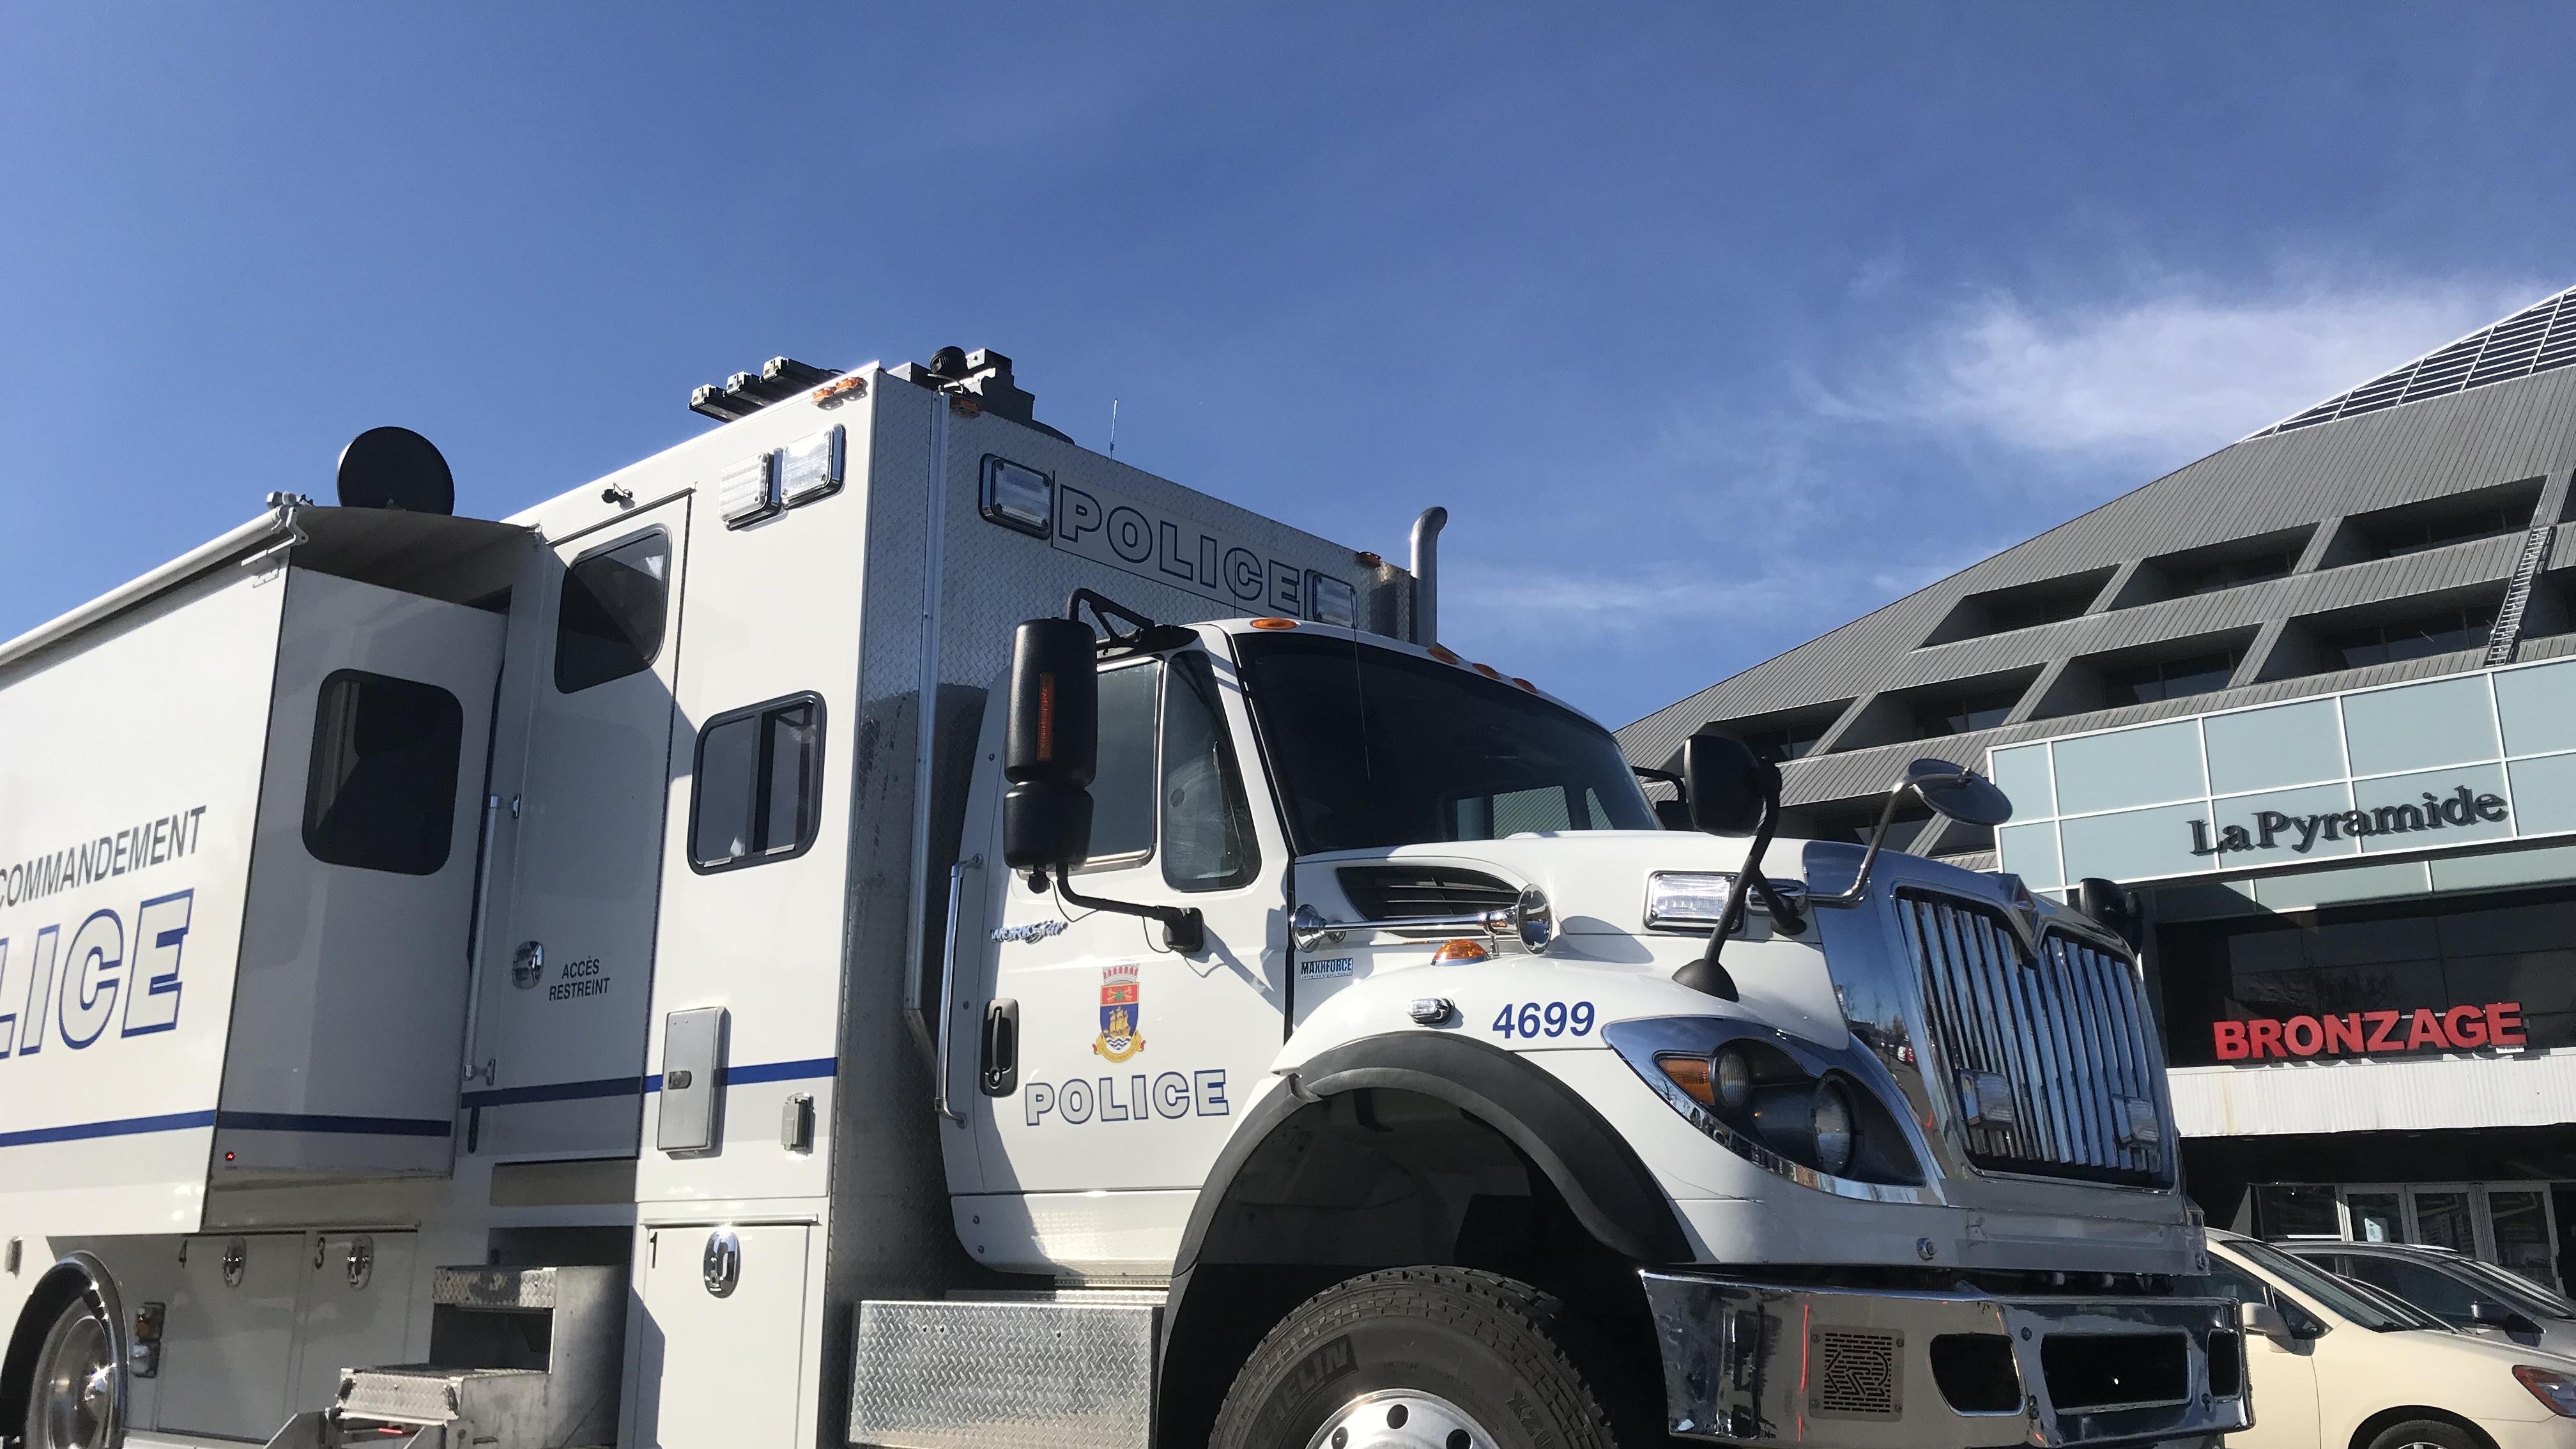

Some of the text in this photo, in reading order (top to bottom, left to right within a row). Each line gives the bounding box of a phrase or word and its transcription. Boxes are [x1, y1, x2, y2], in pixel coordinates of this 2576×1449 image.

[1060, 484, 1300, 617] POLICE
[561, 954, 600, 979] ACCÈS
[549, 977, 611, 1002] RESTREINT
[1492, 1000, 1595, 1039] 4699
[2213, 1002, 2524, 1061] BRONZAGE
[1025, 1068, 1230, 1126] POLICE
[314, 1236, 326, 1269] 3
[650, 1231, 658, 1269] 1
